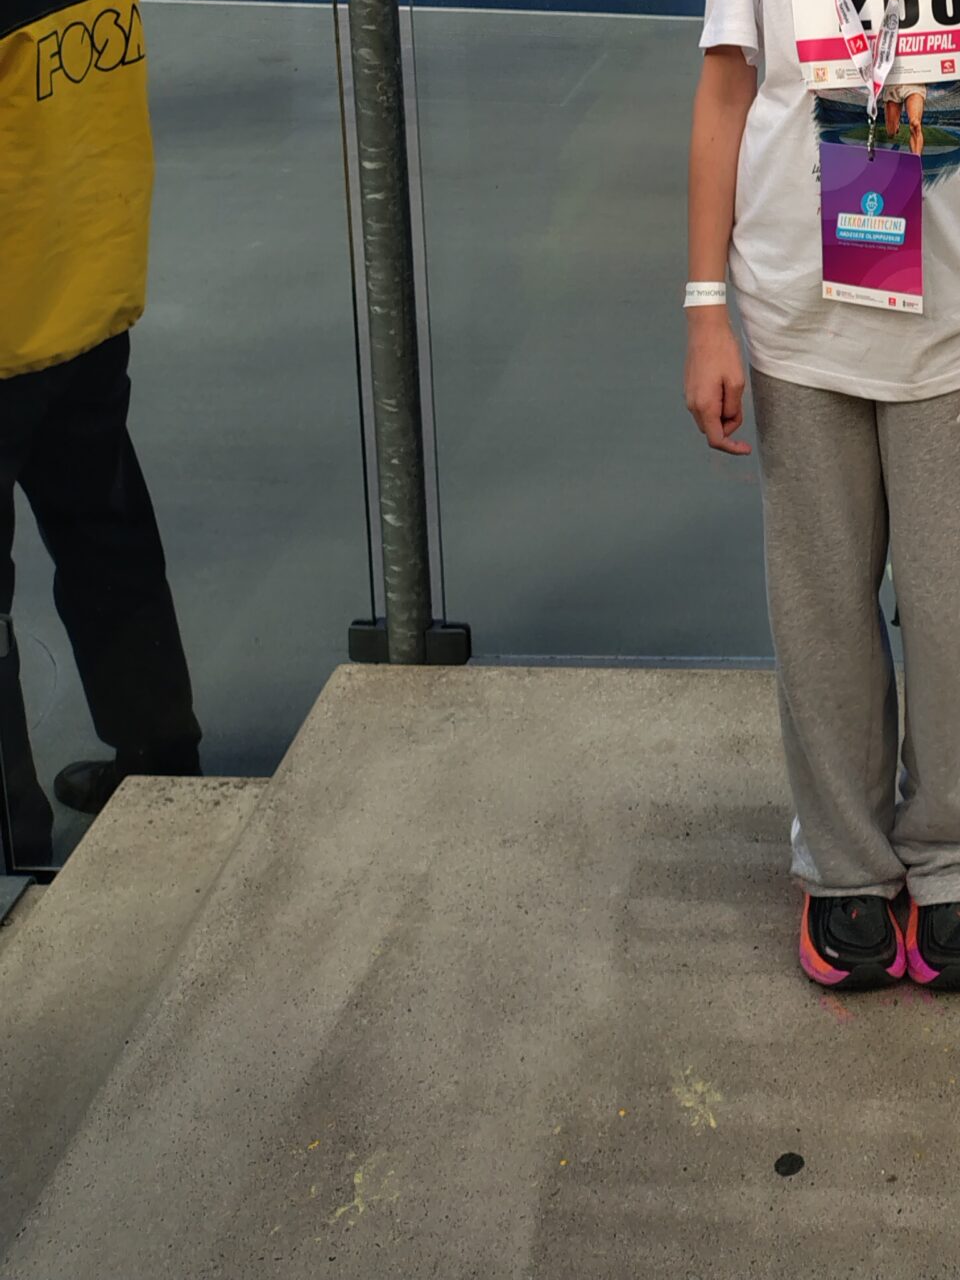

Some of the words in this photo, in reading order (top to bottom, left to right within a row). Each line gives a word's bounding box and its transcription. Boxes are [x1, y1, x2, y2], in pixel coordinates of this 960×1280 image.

[898, 35, 926, 53] RZUT
[927, 33, 957, 51] PPAL.
[839, 215, 904, 231] LEKKOATLETYCZNE
